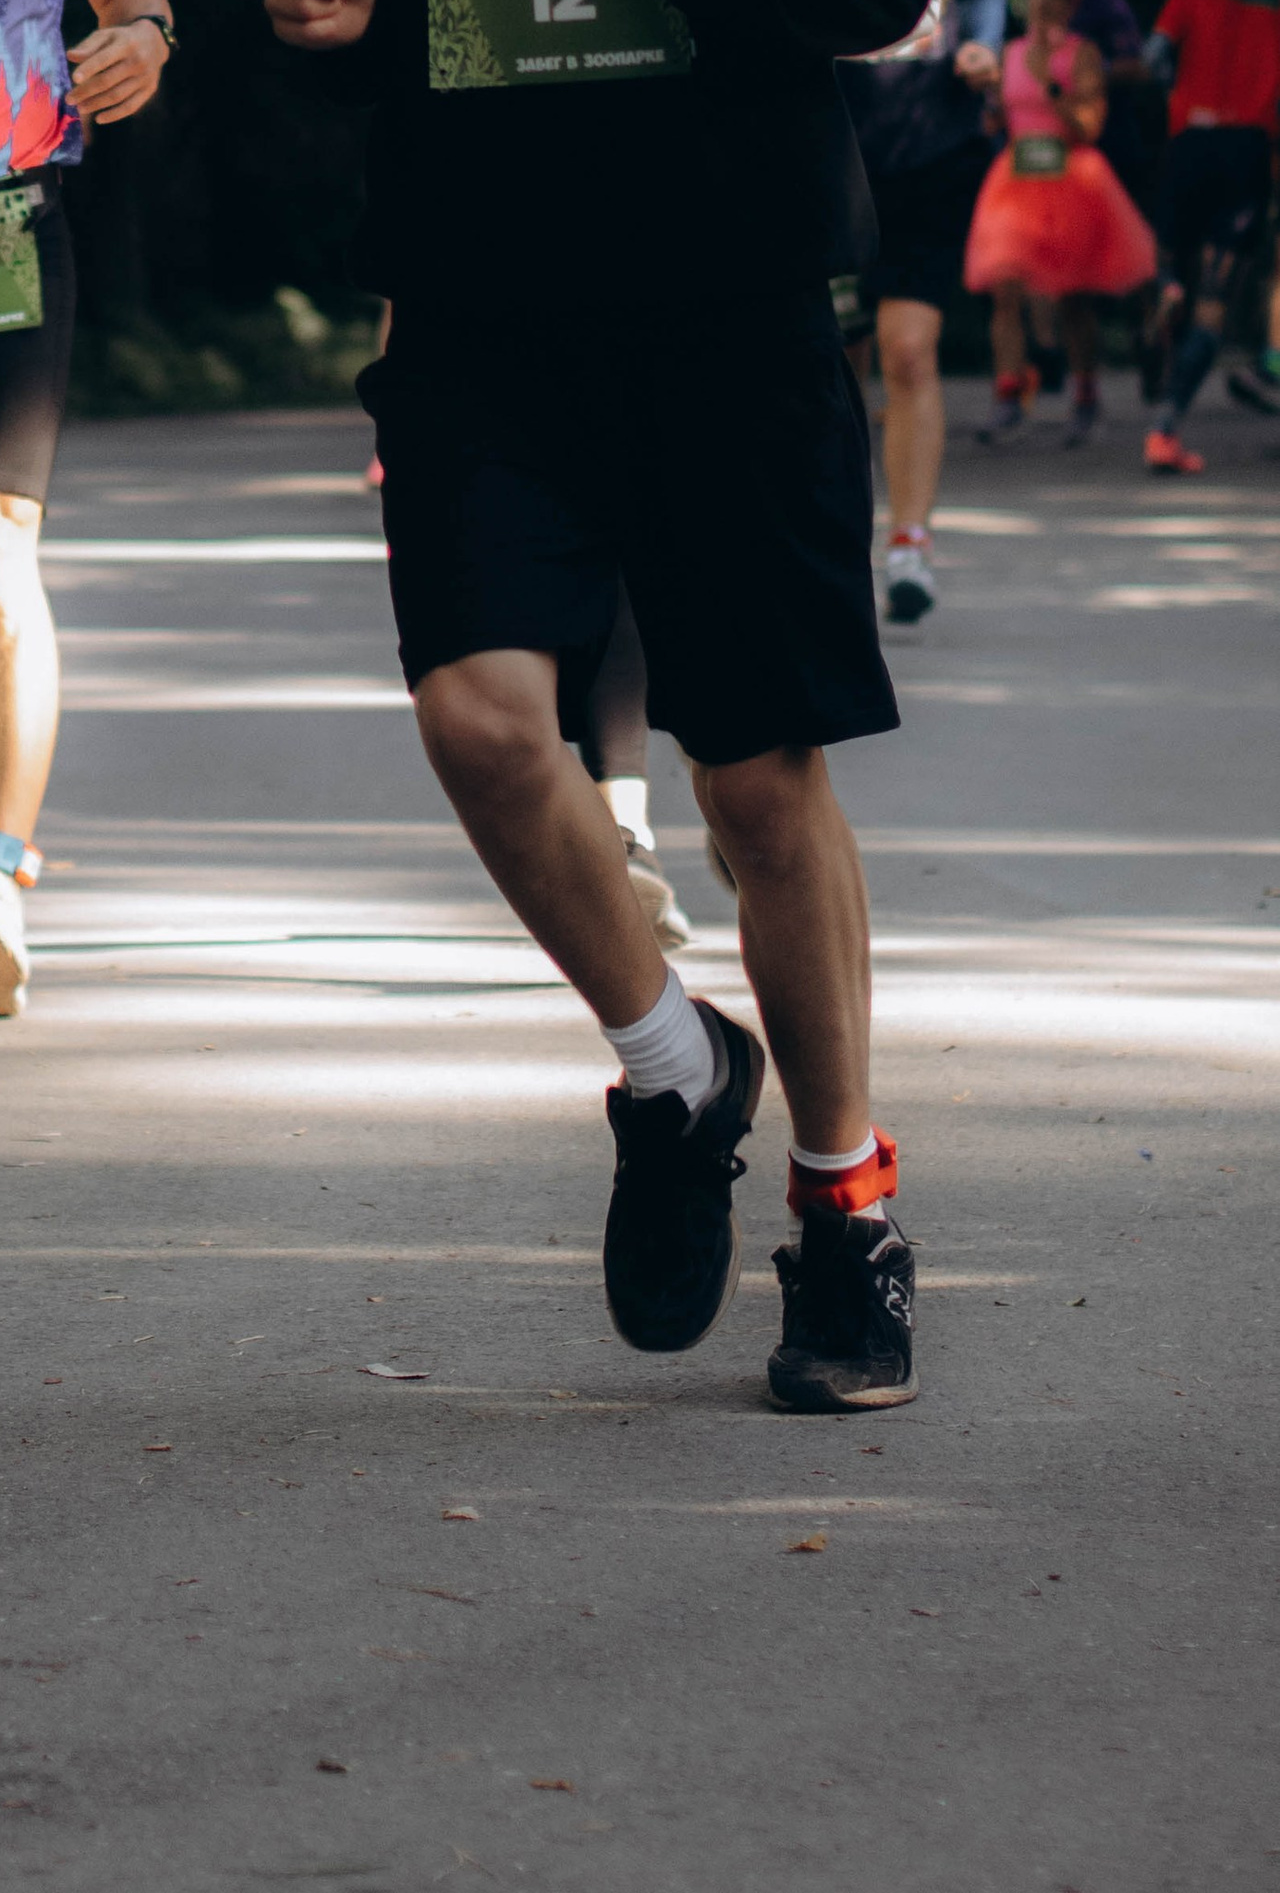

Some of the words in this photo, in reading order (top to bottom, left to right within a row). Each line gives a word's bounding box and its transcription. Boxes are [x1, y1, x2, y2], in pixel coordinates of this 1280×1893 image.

[516, 56, 562, 73] ЗАБЕГ
[566, 54, 578, 69] В
[582, 49, 665, 68] ЗООПАРКЕ
